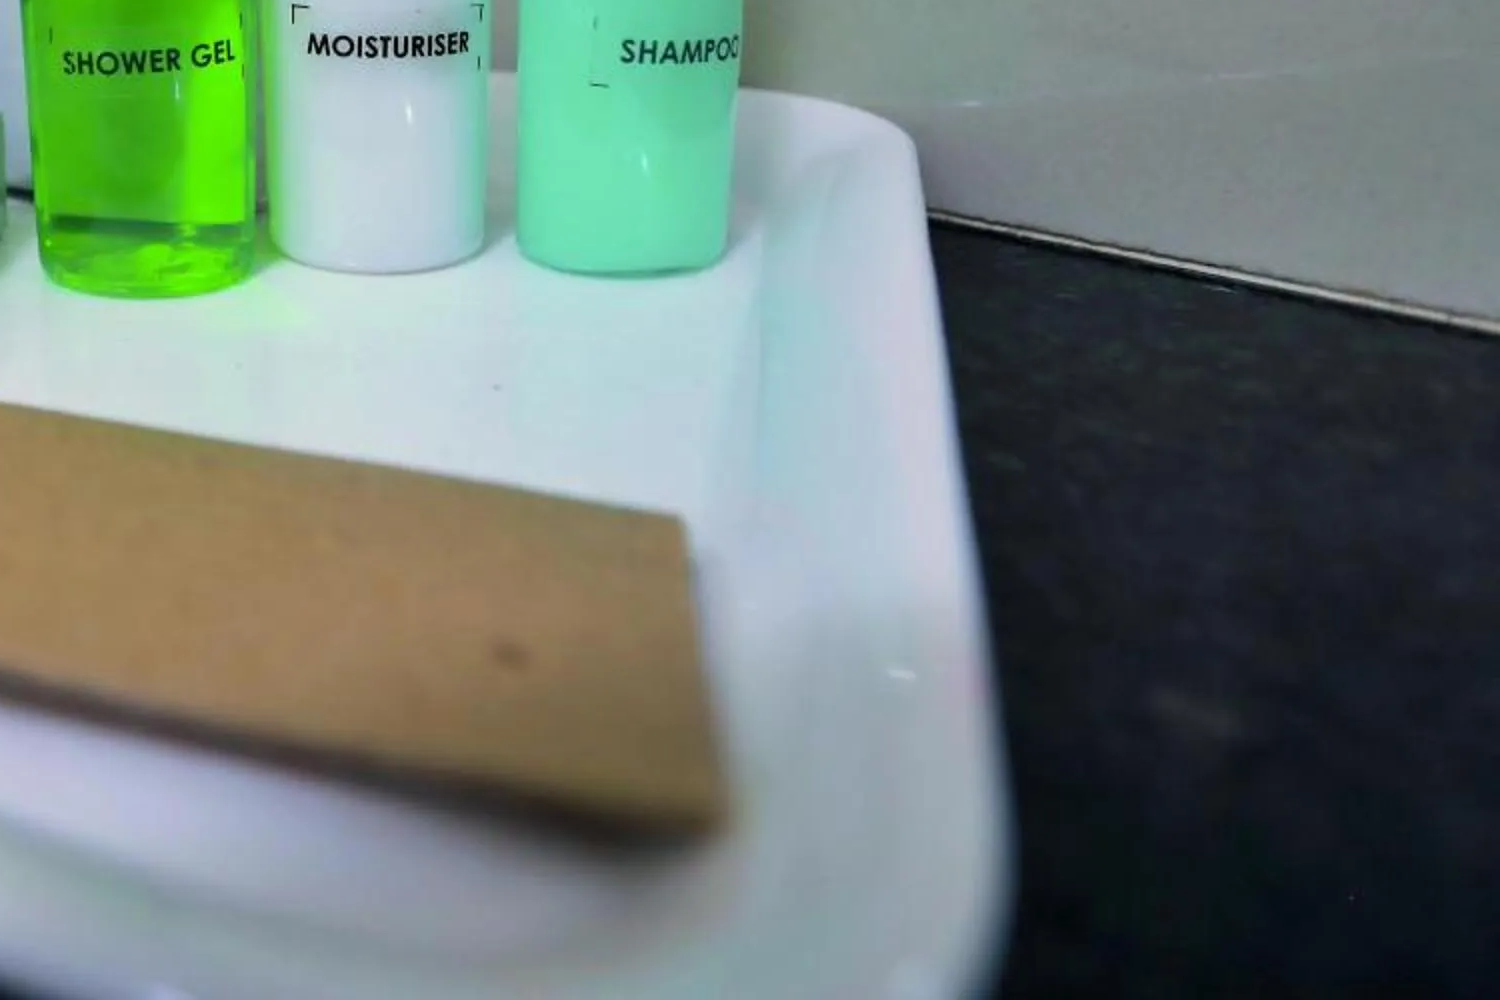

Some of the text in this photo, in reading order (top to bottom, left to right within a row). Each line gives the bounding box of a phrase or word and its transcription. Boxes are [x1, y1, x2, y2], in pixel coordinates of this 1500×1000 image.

[63, 39, 236, 75] SHOWER GEL
[307, 31, 469, 58] MOISTURISER
